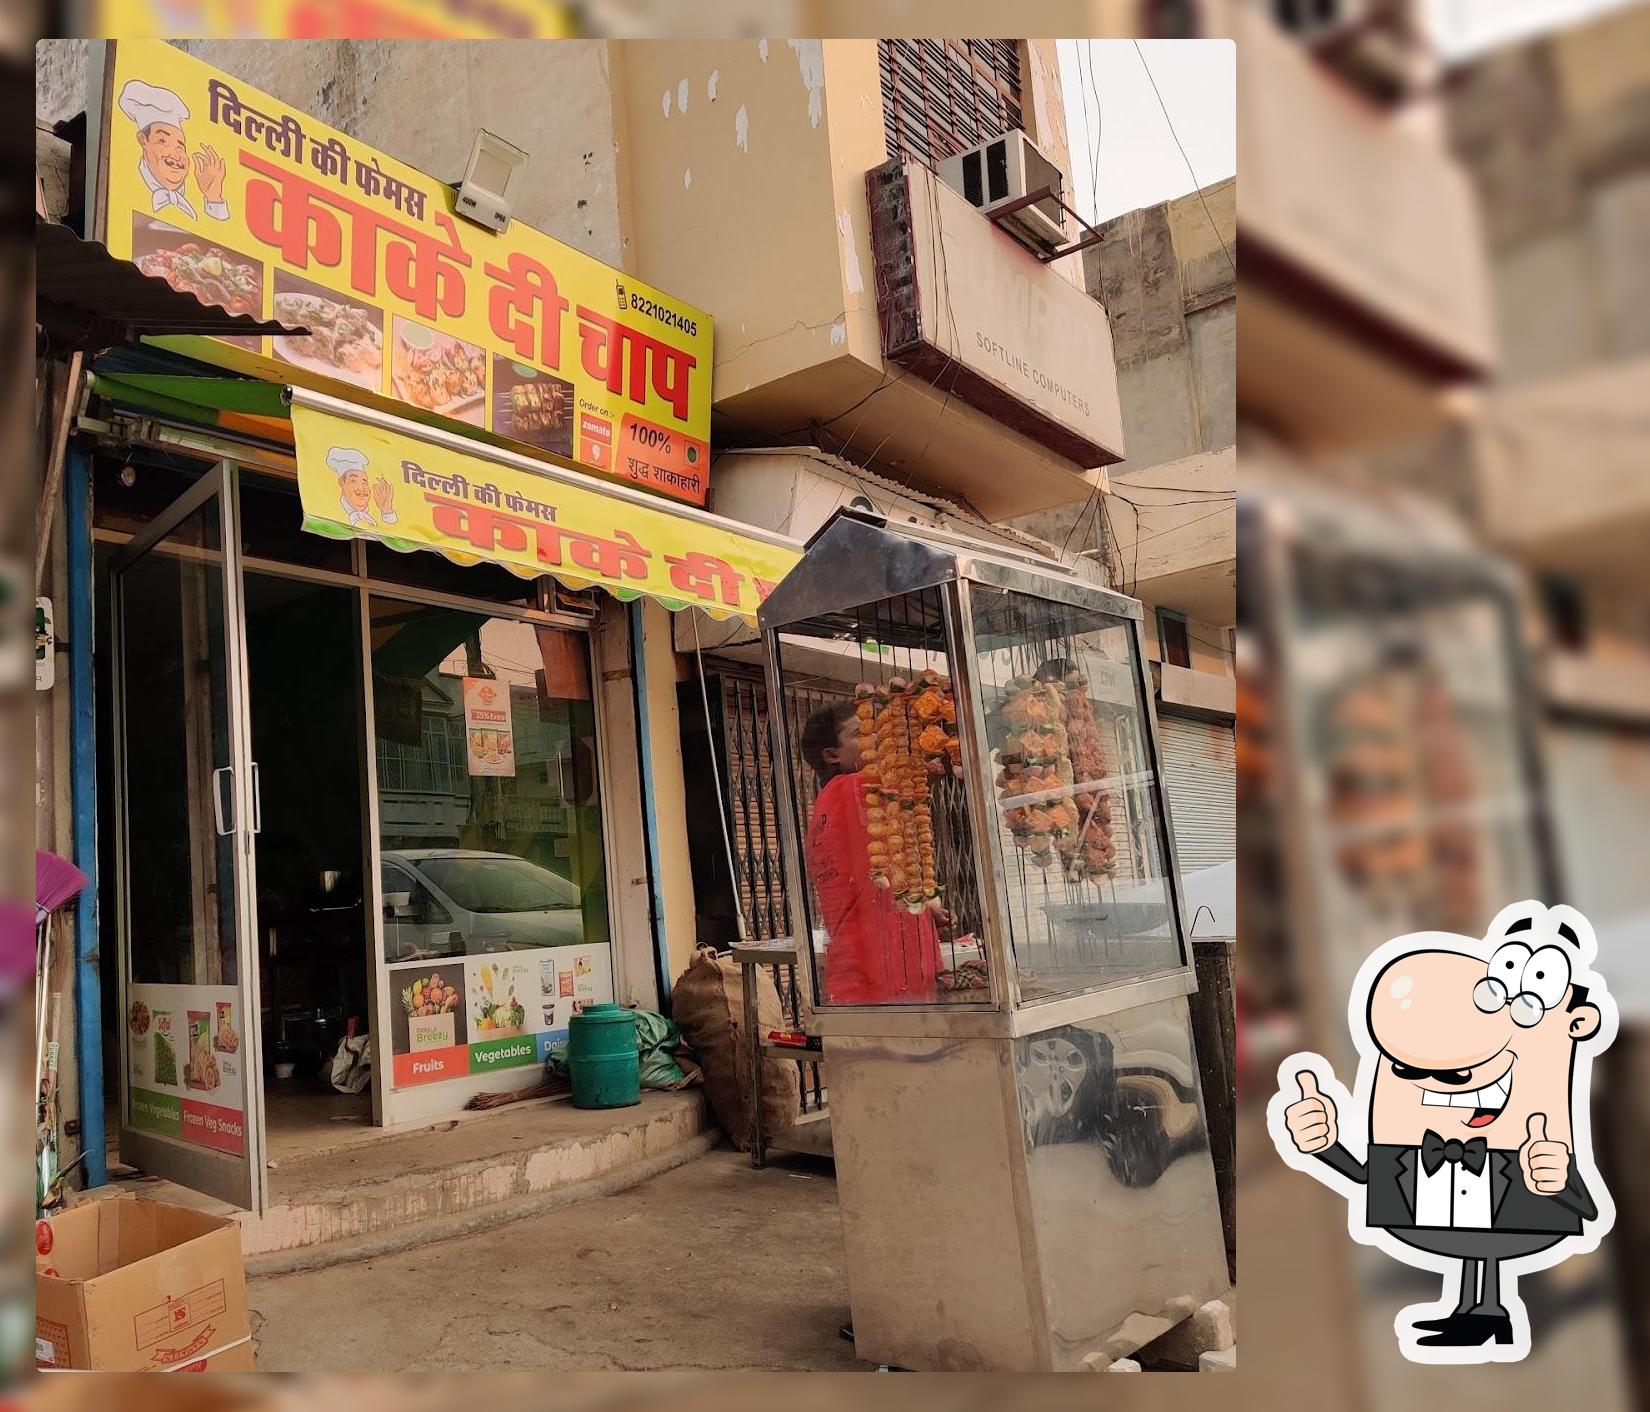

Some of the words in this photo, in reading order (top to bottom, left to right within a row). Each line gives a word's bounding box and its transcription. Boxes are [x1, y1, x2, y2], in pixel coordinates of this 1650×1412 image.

[207, 79, 306, 164] दिल्ली
[310, 138, 351, 186] की
[354, 157, 427, 221] फेमस
[238, 148, 472, 322] काके
[483, 251, 569, 371] दी
[576, 303, 697, 422] चाप
[631, 293, 697, 337] 8221021405
[976, 331, 1030, 379] SOFTLINE
[1032, 369, 1090, 417] COMPUTERS
[578, 398, 598, 412] Order
[599, 408, 609, 416] on
[582, 420, 611, 437] zomato
[630, 422, 671, 454] 100%
[400, 460, 471, 500] दिल्ली
[473, 483, 502, 508] की
[504, 490, 558, 522] फेमस
[628, 456, 649, 479] शुद्ध
[652, 464, 700, 494] शाकाहारी
[423, 490, 653, 580] काके
[663, 551, 745, 606] दी
[416, 1031, 448, 1044] Breezy
[475, 1044, 531, 1064] Vegetables
[413, 1059, 444, 1074] Fruits
[183, 1110, 204, 1127] Frozen
[204, 1116, 217, 1132] Veg
[218, 1118, 242, 1137] Snacks
